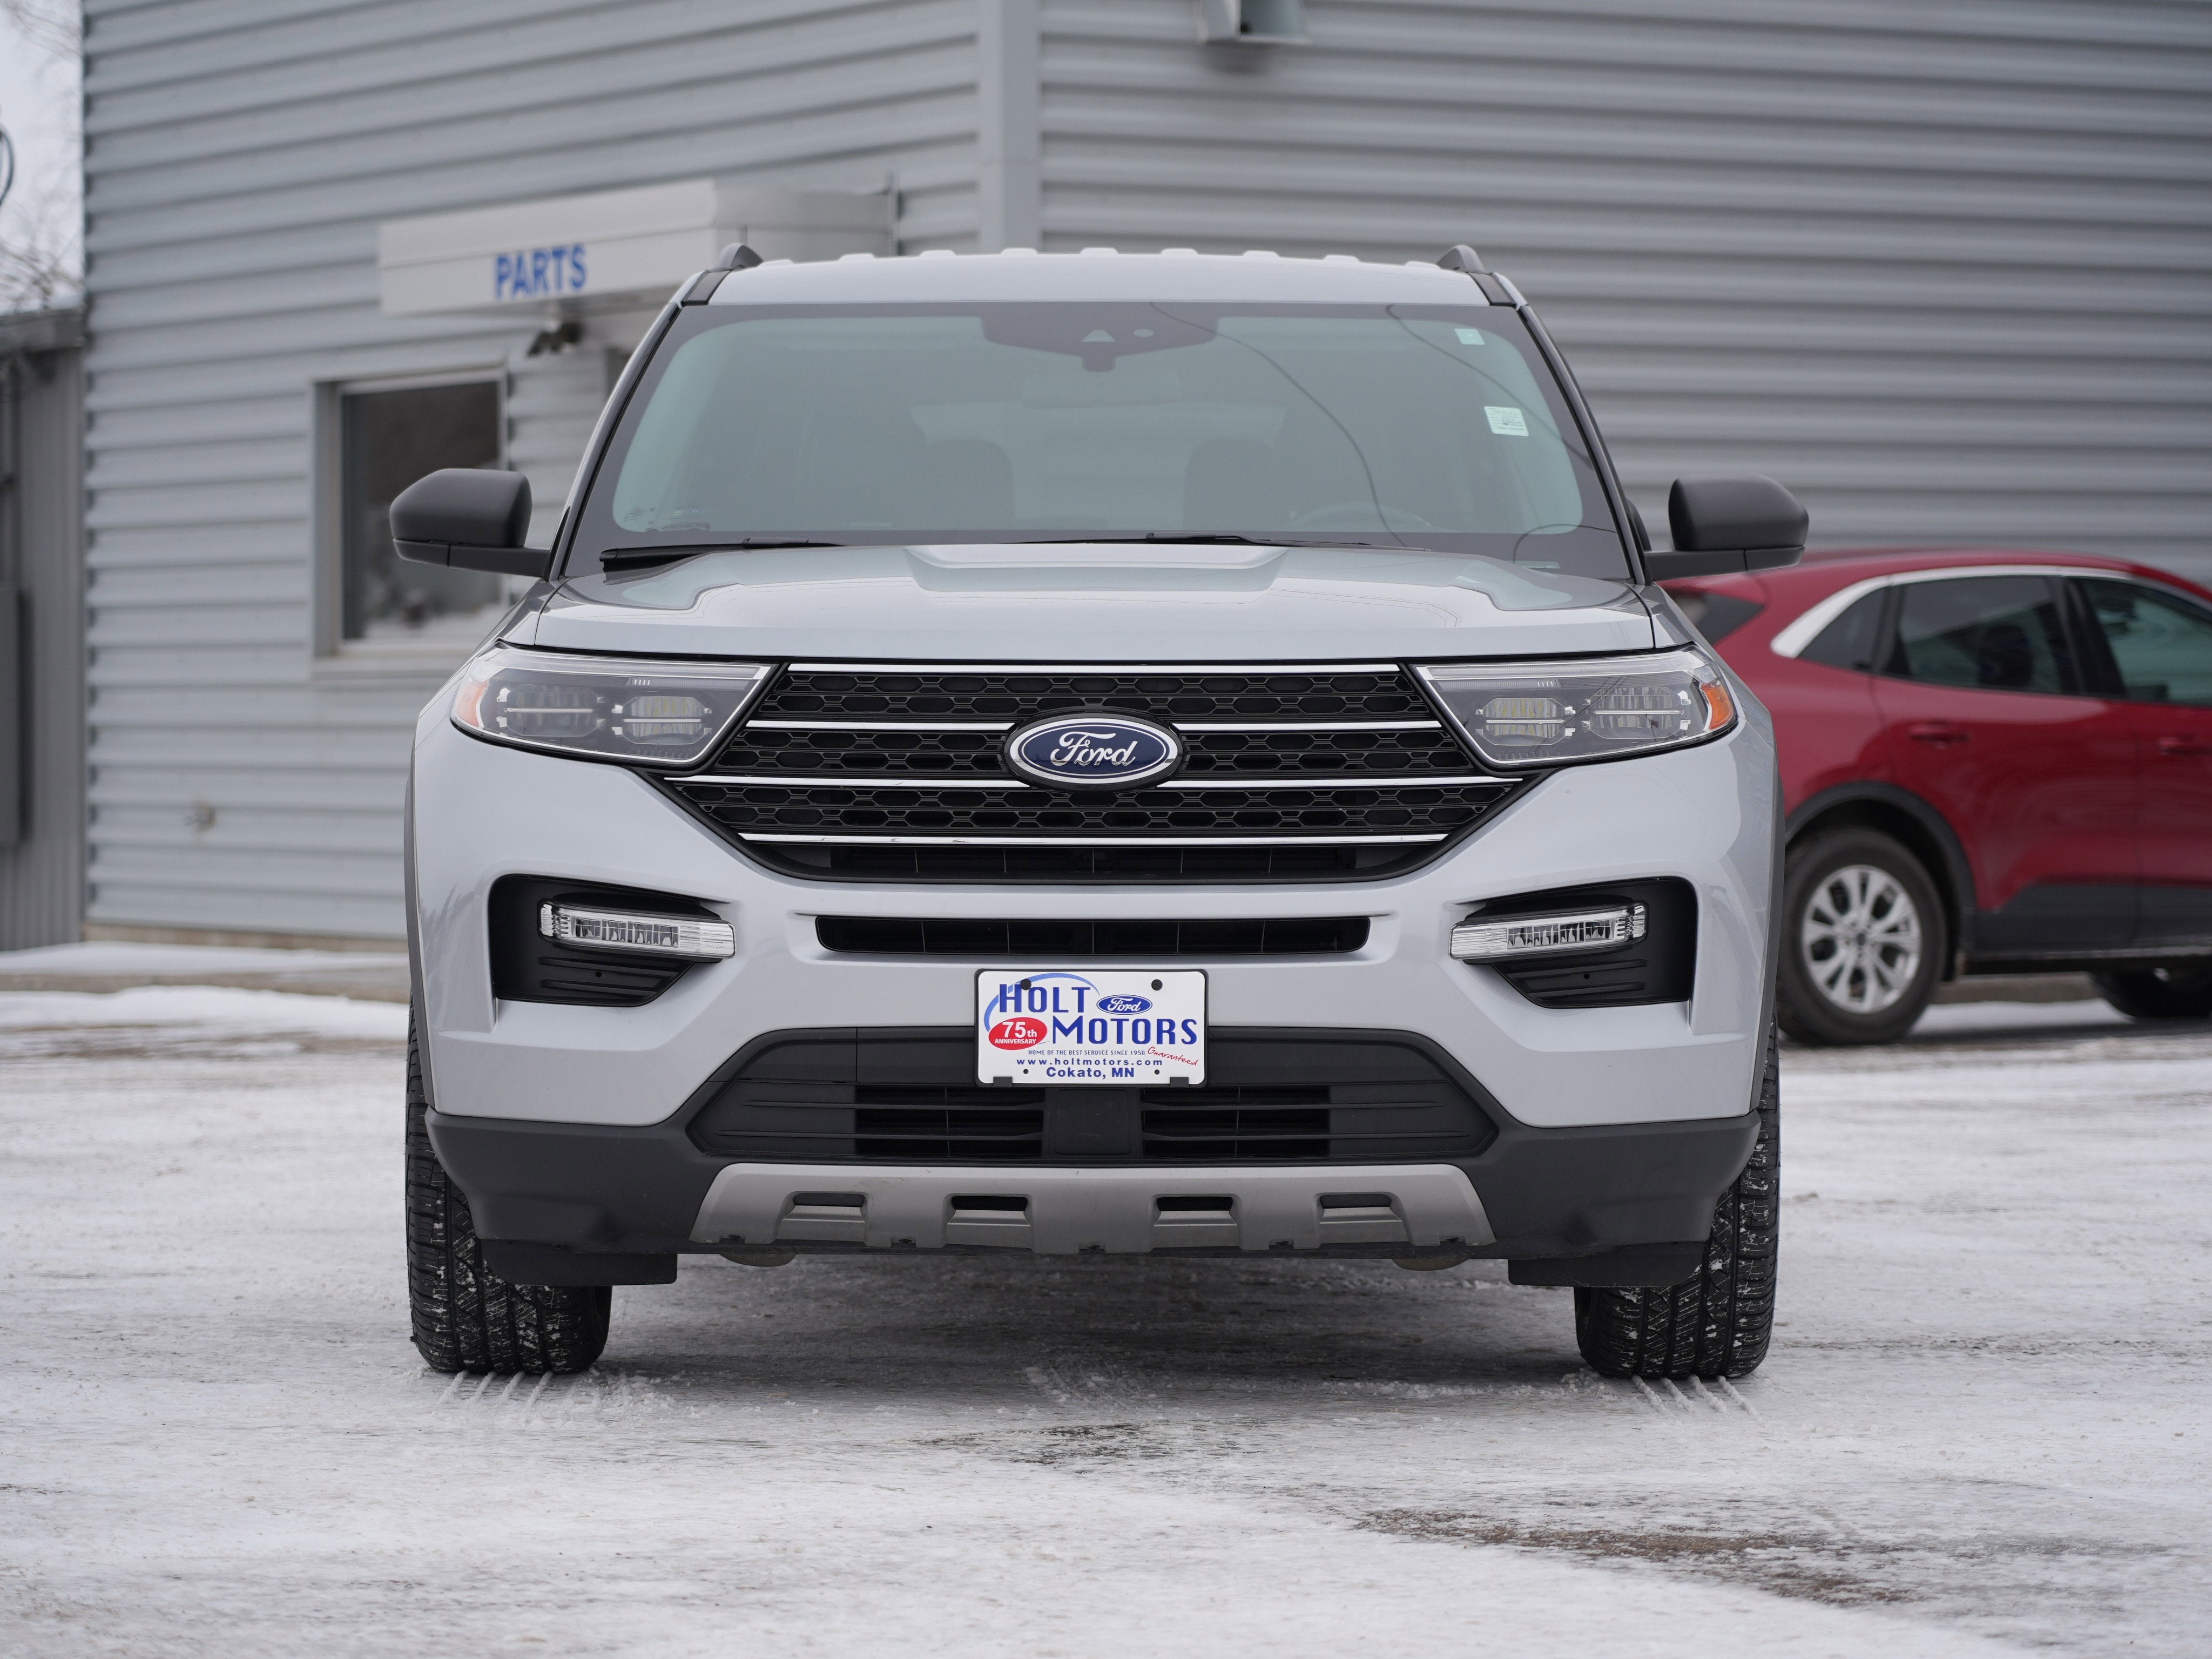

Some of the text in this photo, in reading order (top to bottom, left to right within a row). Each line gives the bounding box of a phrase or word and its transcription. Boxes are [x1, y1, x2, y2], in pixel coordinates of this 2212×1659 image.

[495, 244, 587, 300] PARTS
[1050, 731, 1138, 766] Ford
[999, 984, 1091, 1013] HOLT
[1107, 997, 1142, 1011] Ford
[1002, 1021, 1037, 1038] 75th
[1053, 1015, 1197, 1044] MOTORS
[1148, 1046, 1198, 1065] Guaranteed
[1046, 1067, 1135, 1079] Cokato, MN
